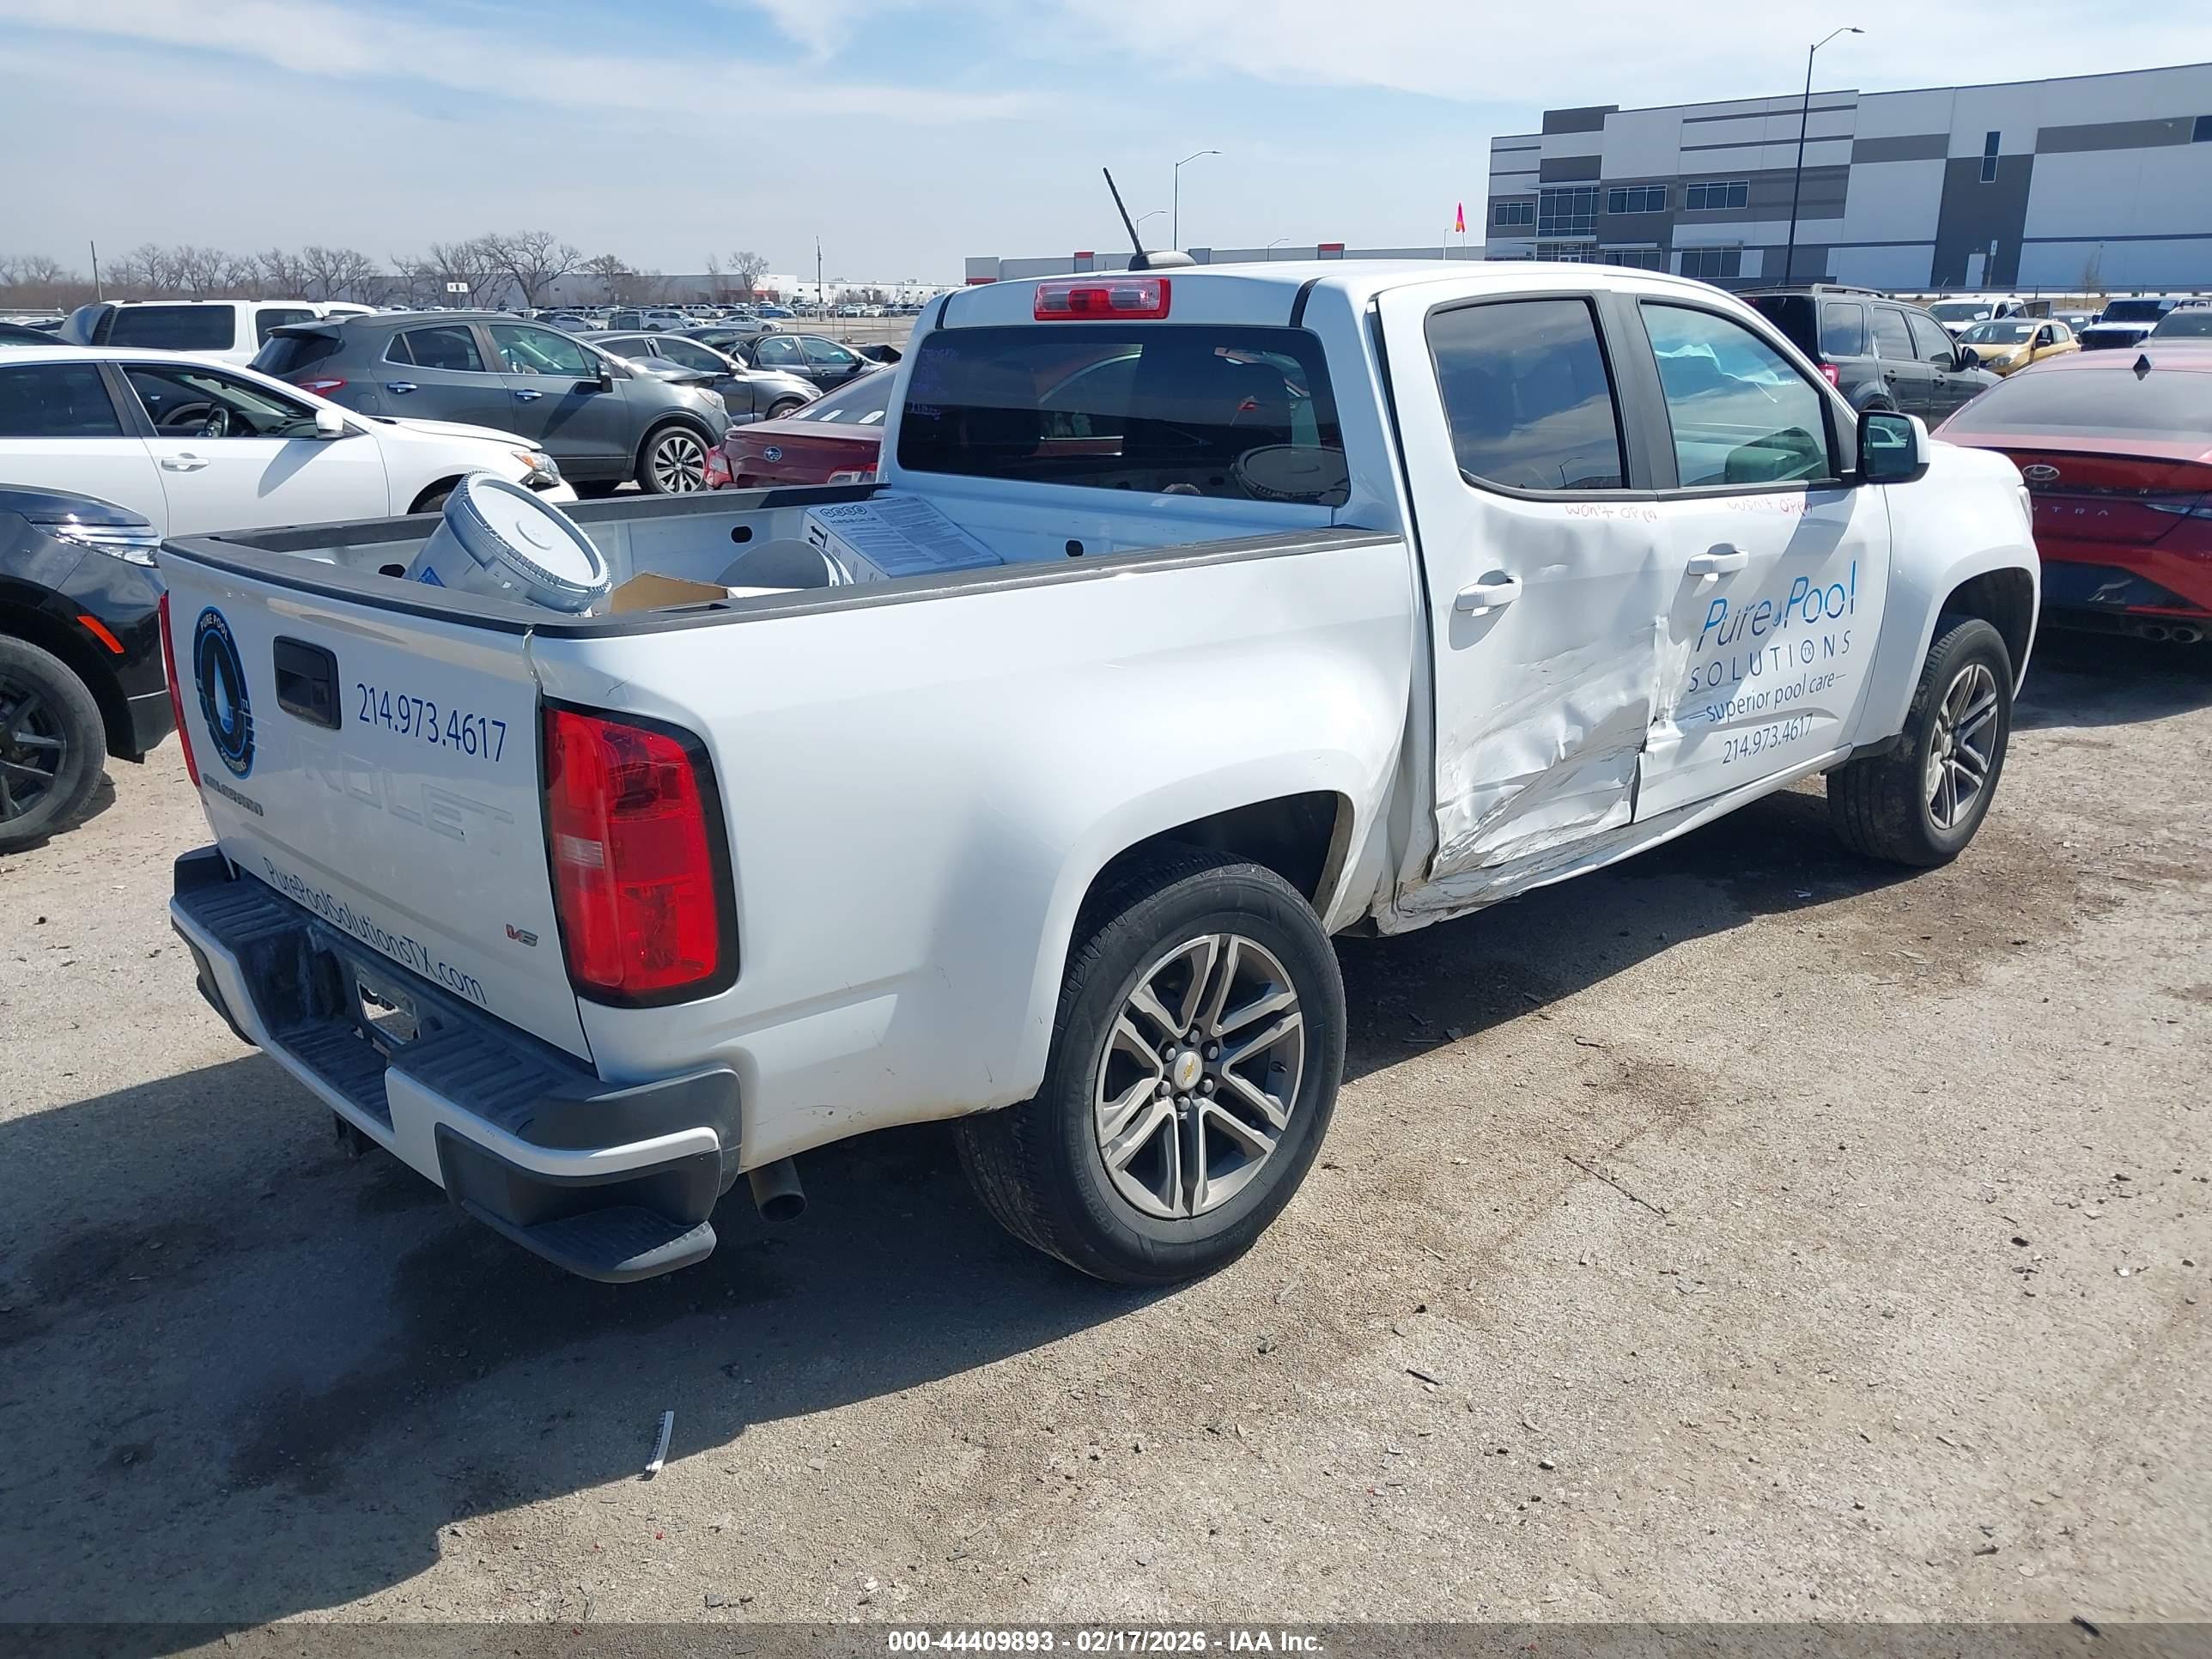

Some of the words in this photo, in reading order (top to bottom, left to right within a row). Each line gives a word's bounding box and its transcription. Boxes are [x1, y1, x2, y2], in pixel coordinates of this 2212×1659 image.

[200, 613, 214, 632] PURE
[213, 614, 228, 641] POOL
[1696, 598, 1772, 653] Pure
[1784, 560, 1856, 629] Pool
[1688, 630, 1851, 692] SOLUTIONS
[357, 683, 507, 763] 214.973.4617
[1706, 690, 1771, 722] superior
[1773, 673, 1807, 709] pool
[1809, 672, 1835, 694] care
[1722, 713, 1814, 764] 214.973.4617
[262, 857, 488, 1006] PurePoolSolutionsTX.com
[505, 923, 539, 947] V6
